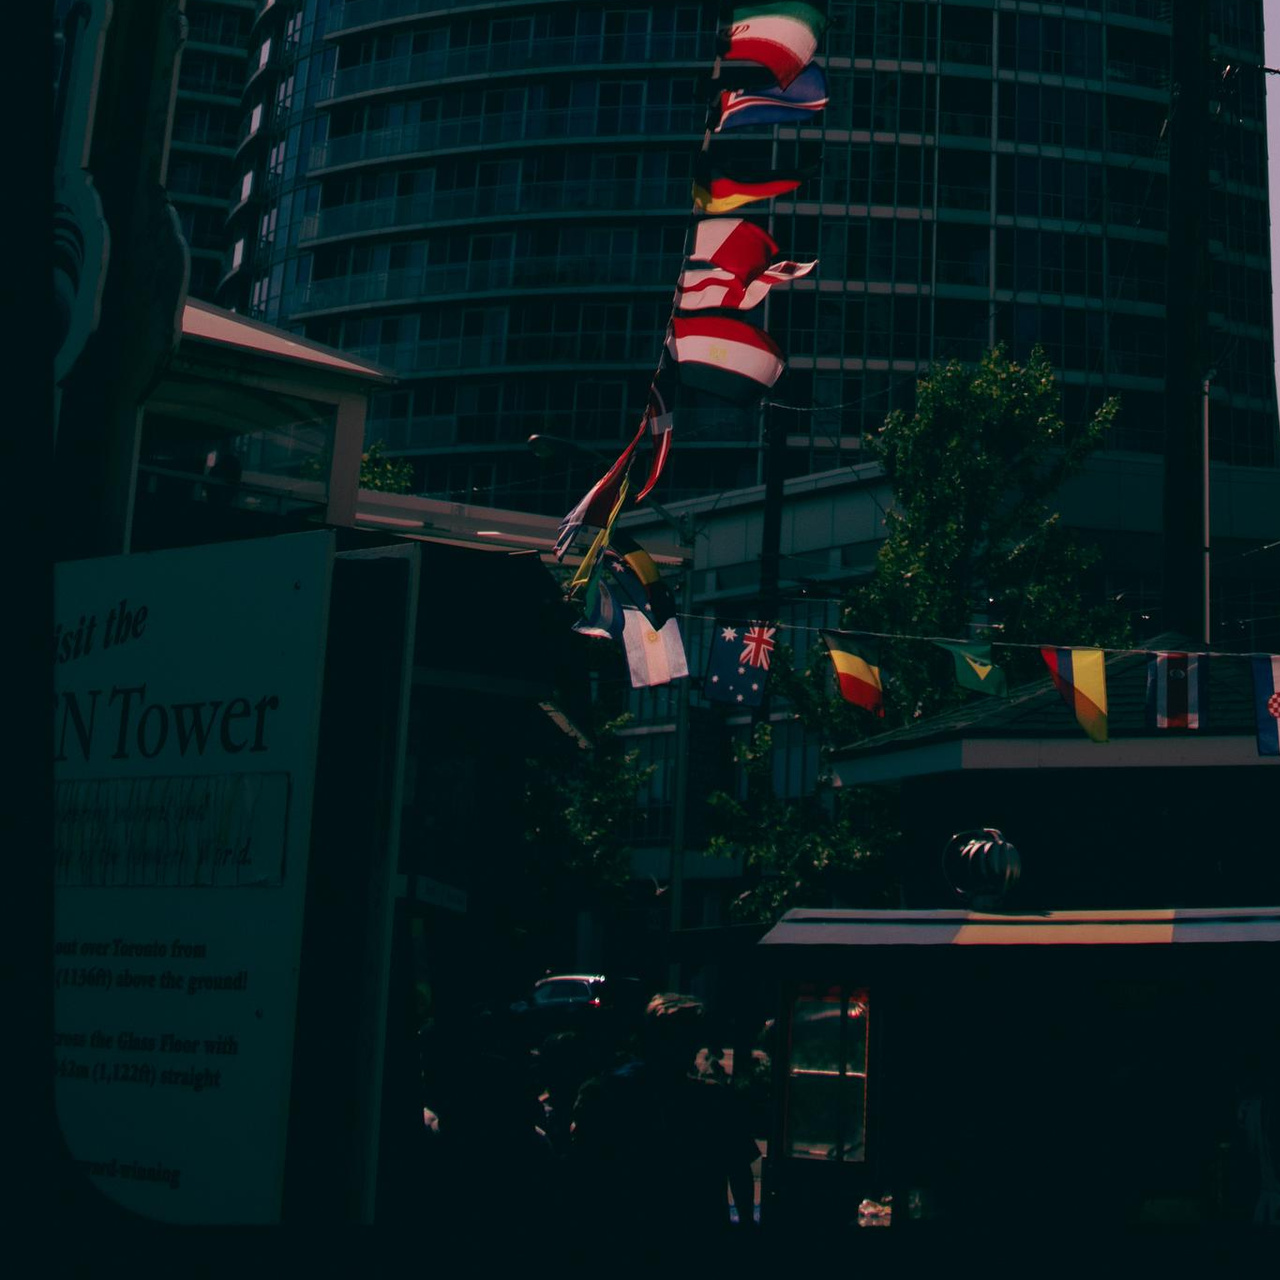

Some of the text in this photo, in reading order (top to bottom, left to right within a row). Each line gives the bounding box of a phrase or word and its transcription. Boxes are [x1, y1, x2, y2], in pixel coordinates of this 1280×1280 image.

[54, 598, 148, 665] isit the
[54, 681, 279, 763] N Tower
[79, 941, 110, 957] over
[112, 938, 168, 958] Toronto
[170, 937, 208, 959] from
[115, 969, 156, 988] above
[159, 970, 184, 990] the
[186, 970, 248, 996] ground!
[53, 1030, 239, 1055] cross the Glass Floor with
[160, 1065, 222, 1092] straight
